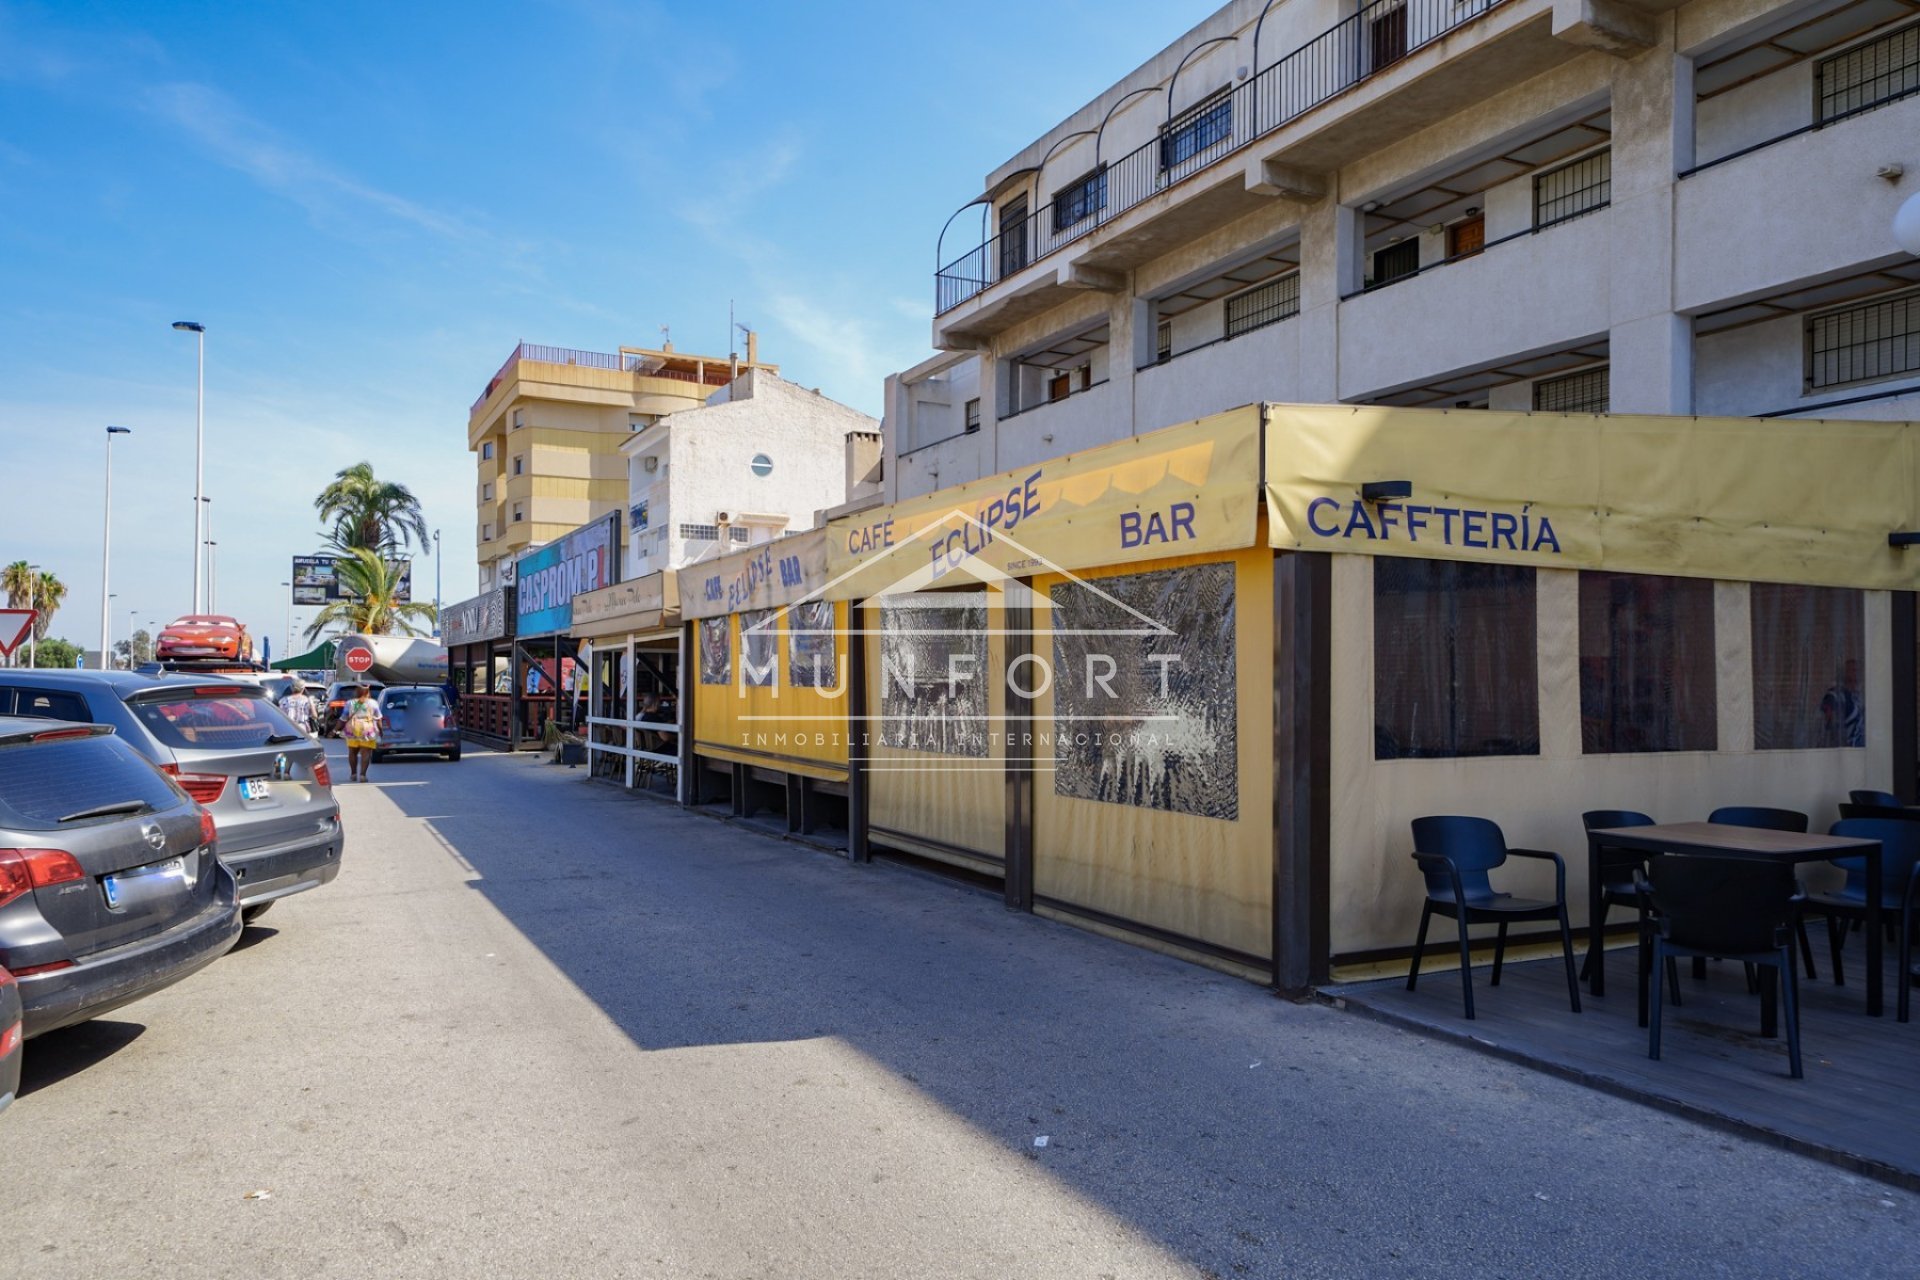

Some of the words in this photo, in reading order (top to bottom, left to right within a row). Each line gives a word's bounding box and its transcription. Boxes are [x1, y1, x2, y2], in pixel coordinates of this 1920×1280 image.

[849, 514, 895, 554] CAFÉ
[929, 469, 1042, 580] ECLIPSE
[1120, 502, 1196, 549] BAR
[779, 555, 802, 587] BAR
[348, 656, 371, 664] STOP
